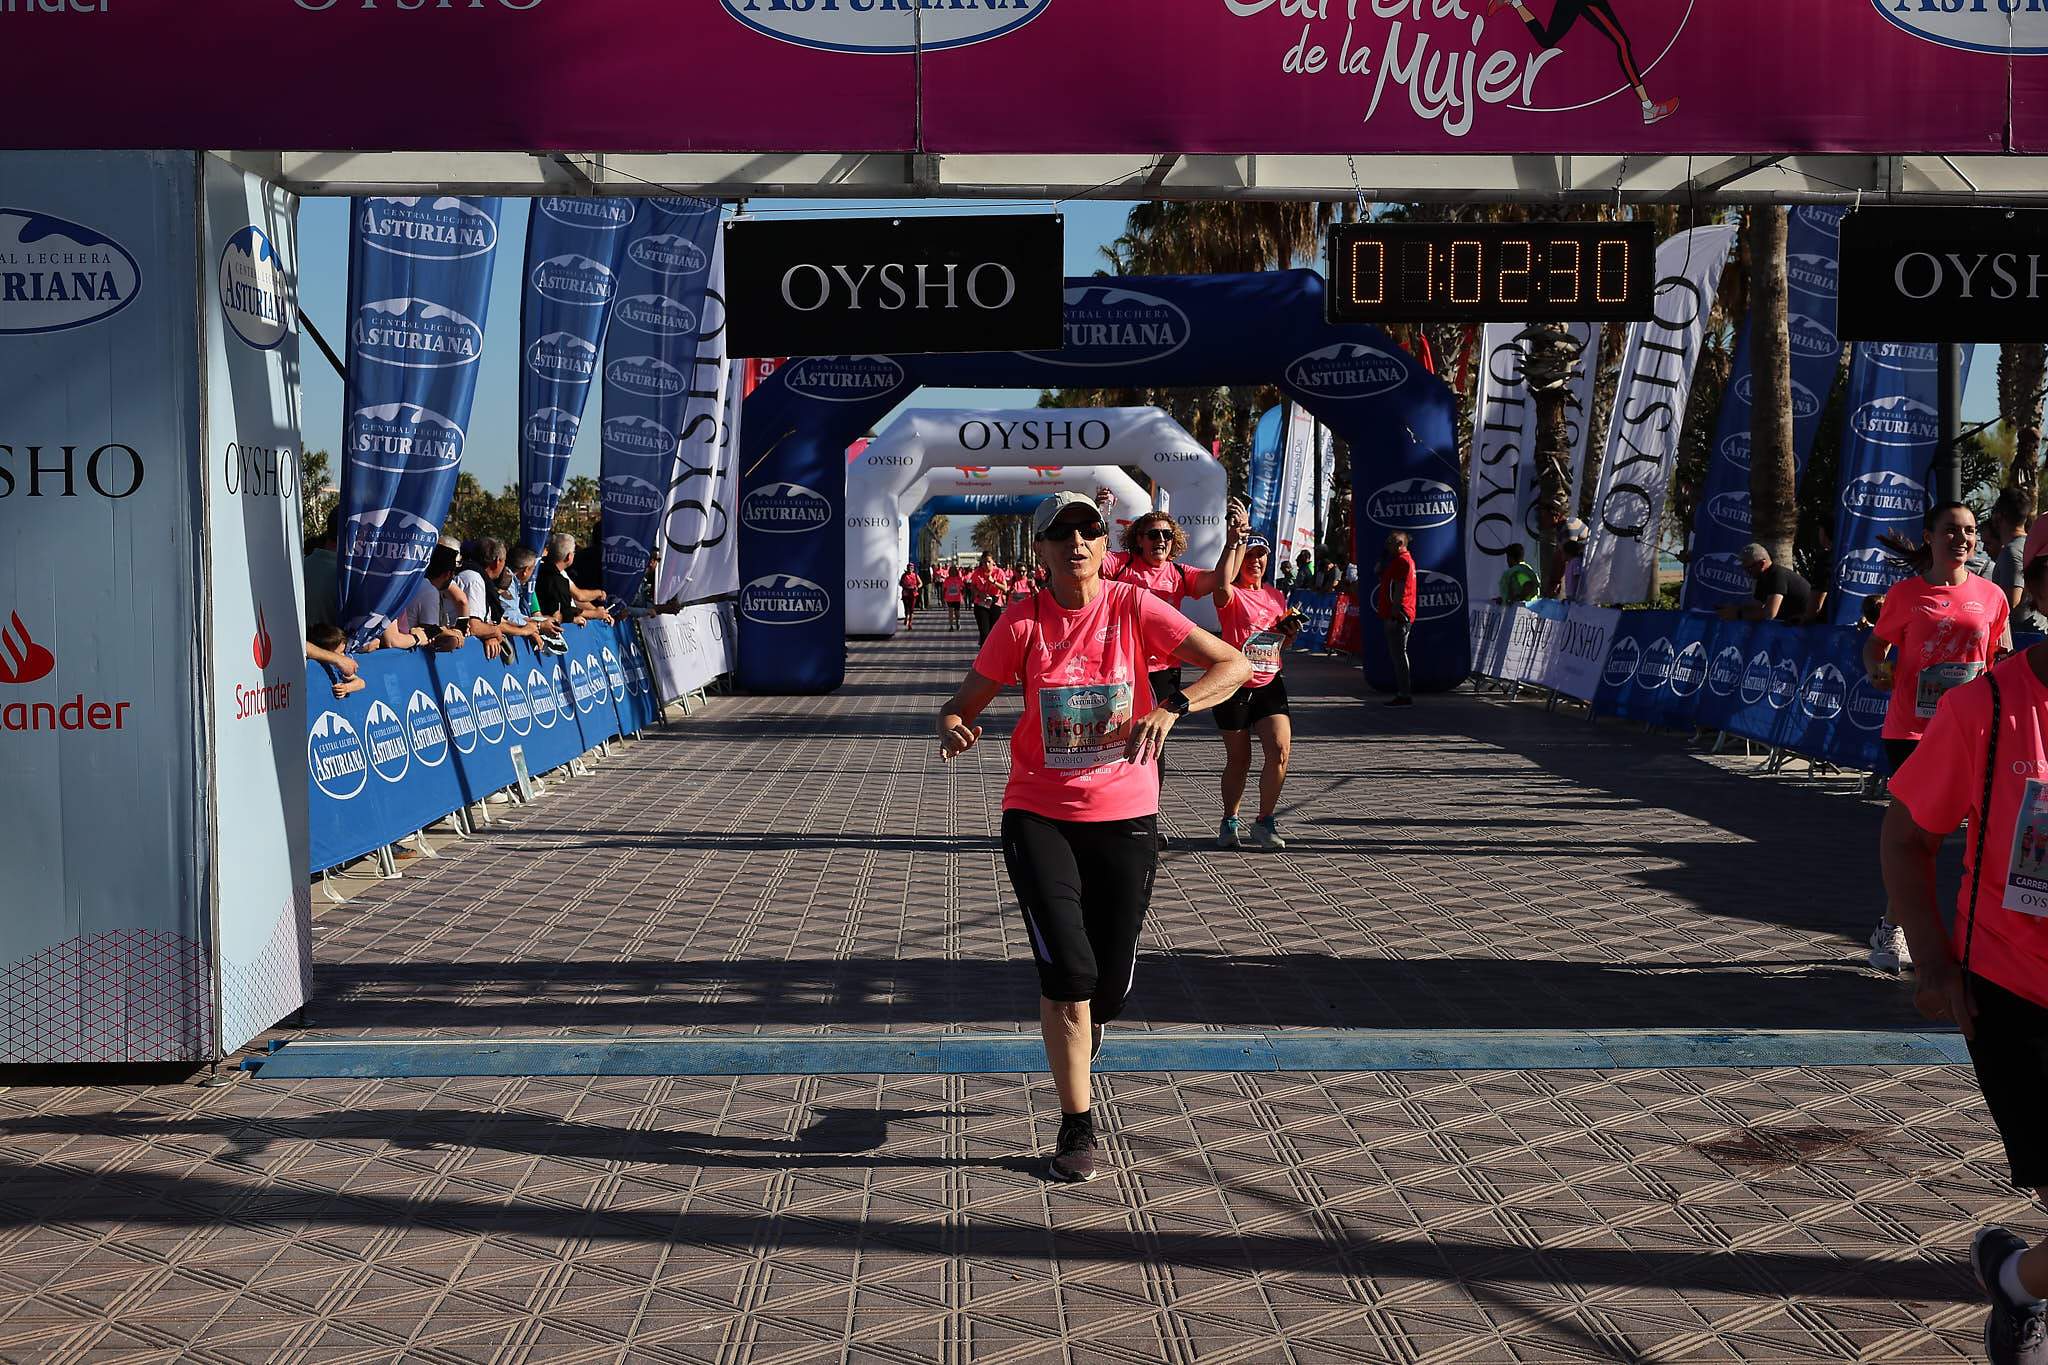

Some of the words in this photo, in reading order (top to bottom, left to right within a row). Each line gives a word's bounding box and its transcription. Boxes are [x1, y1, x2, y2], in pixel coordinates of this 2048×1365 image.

[1282, 24, 1328, 74] de
[1338, 22, 1372, 75] la
[1364, 14, 1564, 137] Mujer
[546, 197, 627, 222] ASTURIANA
[363, 207, 487, 248] ASTURIANA
[27, 253, 111, 265] LECHERA
[632, 242, 700, 269] ASTURIANA
[0, 271, 121, 301] RIANA
[1353, 241, 1629, 303] 01:02:30
[225, 258, 287, 325] ASTURIANA
[781, 262, 1016, 311] OYSHO
[620, 303, 690, 330] ASTURIANA
[1108, 310, 1169, 319] LECHERA
[353, 317, 475, 357] ASTURIANA
[610, 364, 679, 392] ASTURIANA
[791, 367, 895, 387] ASTURIANA
[1295, 365, 1401, 386] ASTURIANA
[1601, 275, 1701, 539] OYSHO
[603, 424, 669, 451] ASTURIANA
[958, 419, 1111, 451] OYSHO
[867, 455, 914, 467] OYSHO
[1153, 451, 1200, 463] OYSHO
[1473, 342, 1526, 557] OYSHO
[224, 442, 294, 499] OYSHO
[744, 502, 826, 521] ASTURIANA
[1373, 498, 1456, 518] ASTURIANA
[1848, 488, 1924, 513] ASTURIANA
[847, 517, 890, 528] OYSHO
[1177, 514, 1220, 526] OYSHO
[846, 578, 889, 590] OYSHO
[743, 592, 824, 611] ASTURIANA
[1560, 619, 1605, 663] OYSHO
[0, 693, 131, 731] ander
[236, 676, 292, 720] Santander
[369, 734, 408, 765] ASTURIANA
[411, 720, 447, 751] ASTURIANA
[313, 747, 365, 782] ASTURIANA
